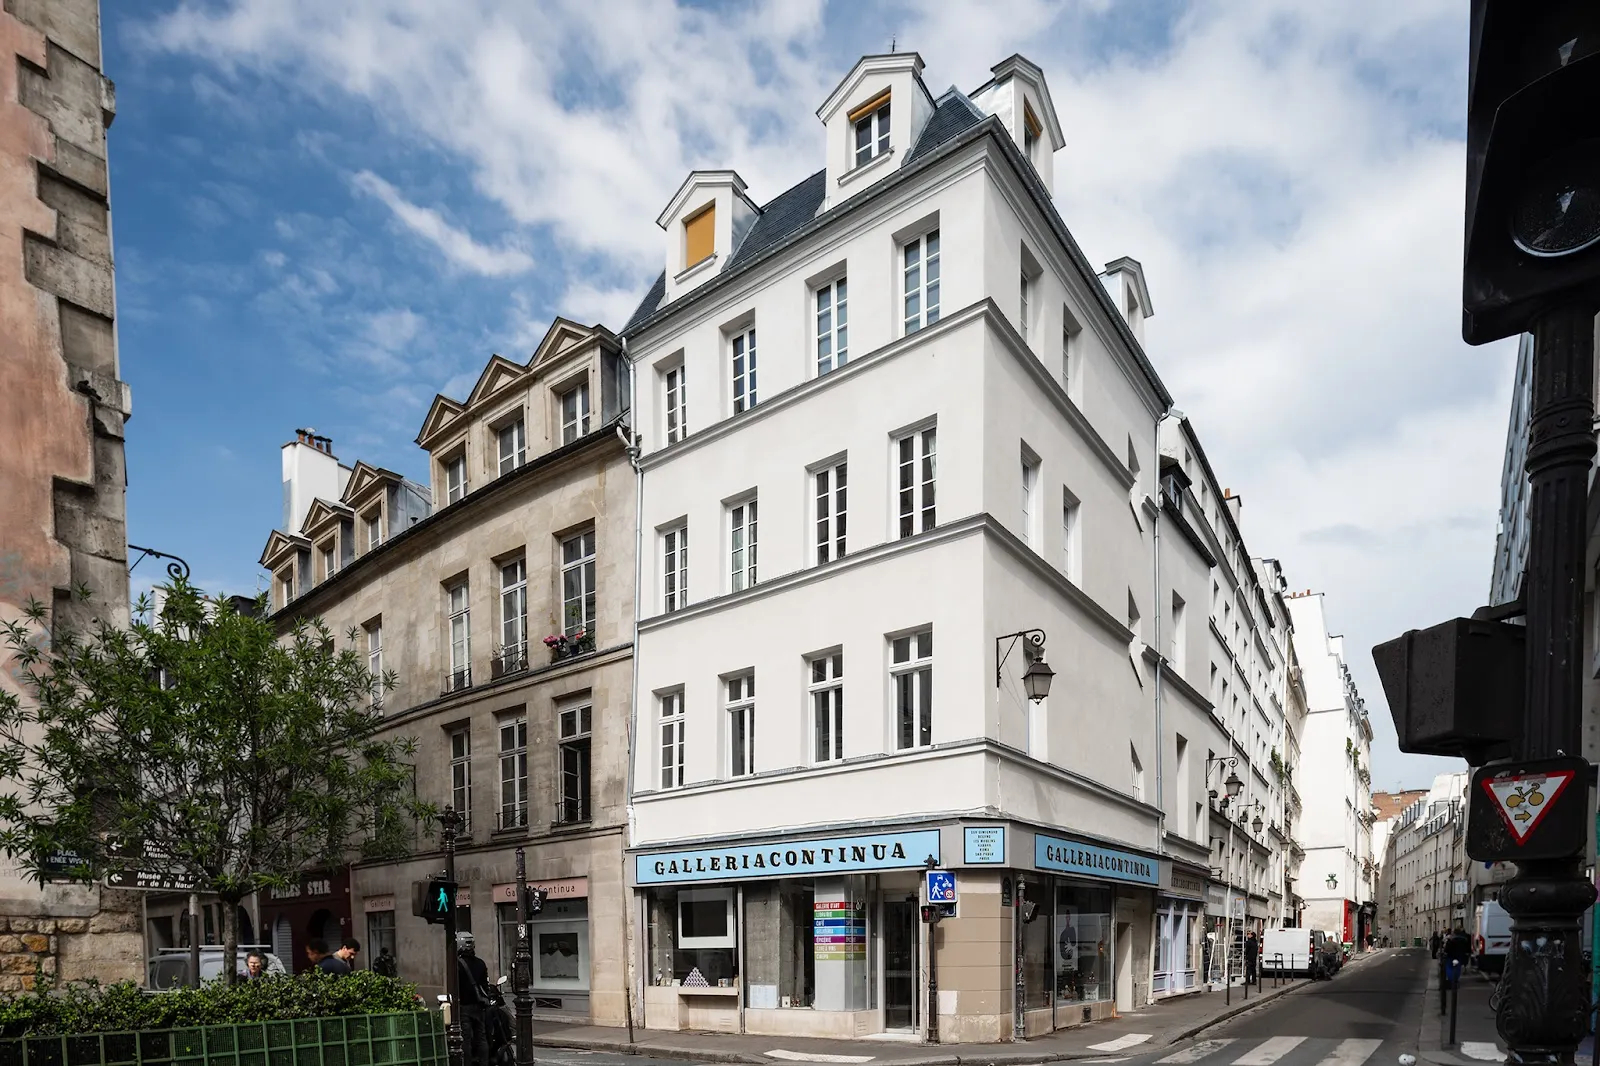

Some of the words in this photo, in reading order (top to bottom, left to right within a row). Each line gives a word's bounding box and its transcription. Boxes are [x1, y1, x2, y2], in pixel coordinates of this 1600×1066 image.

[57, 849, 78, 857] PLACE
[654, 842, 906, 875] GALLERIACONTINUA
[1046, 844, 1151, 877] GALLERIACONTINUA
[137, 872, 161, 880] Musée
[163, 880, 171, 888] la
[307, 880, 331, 896] STAR
